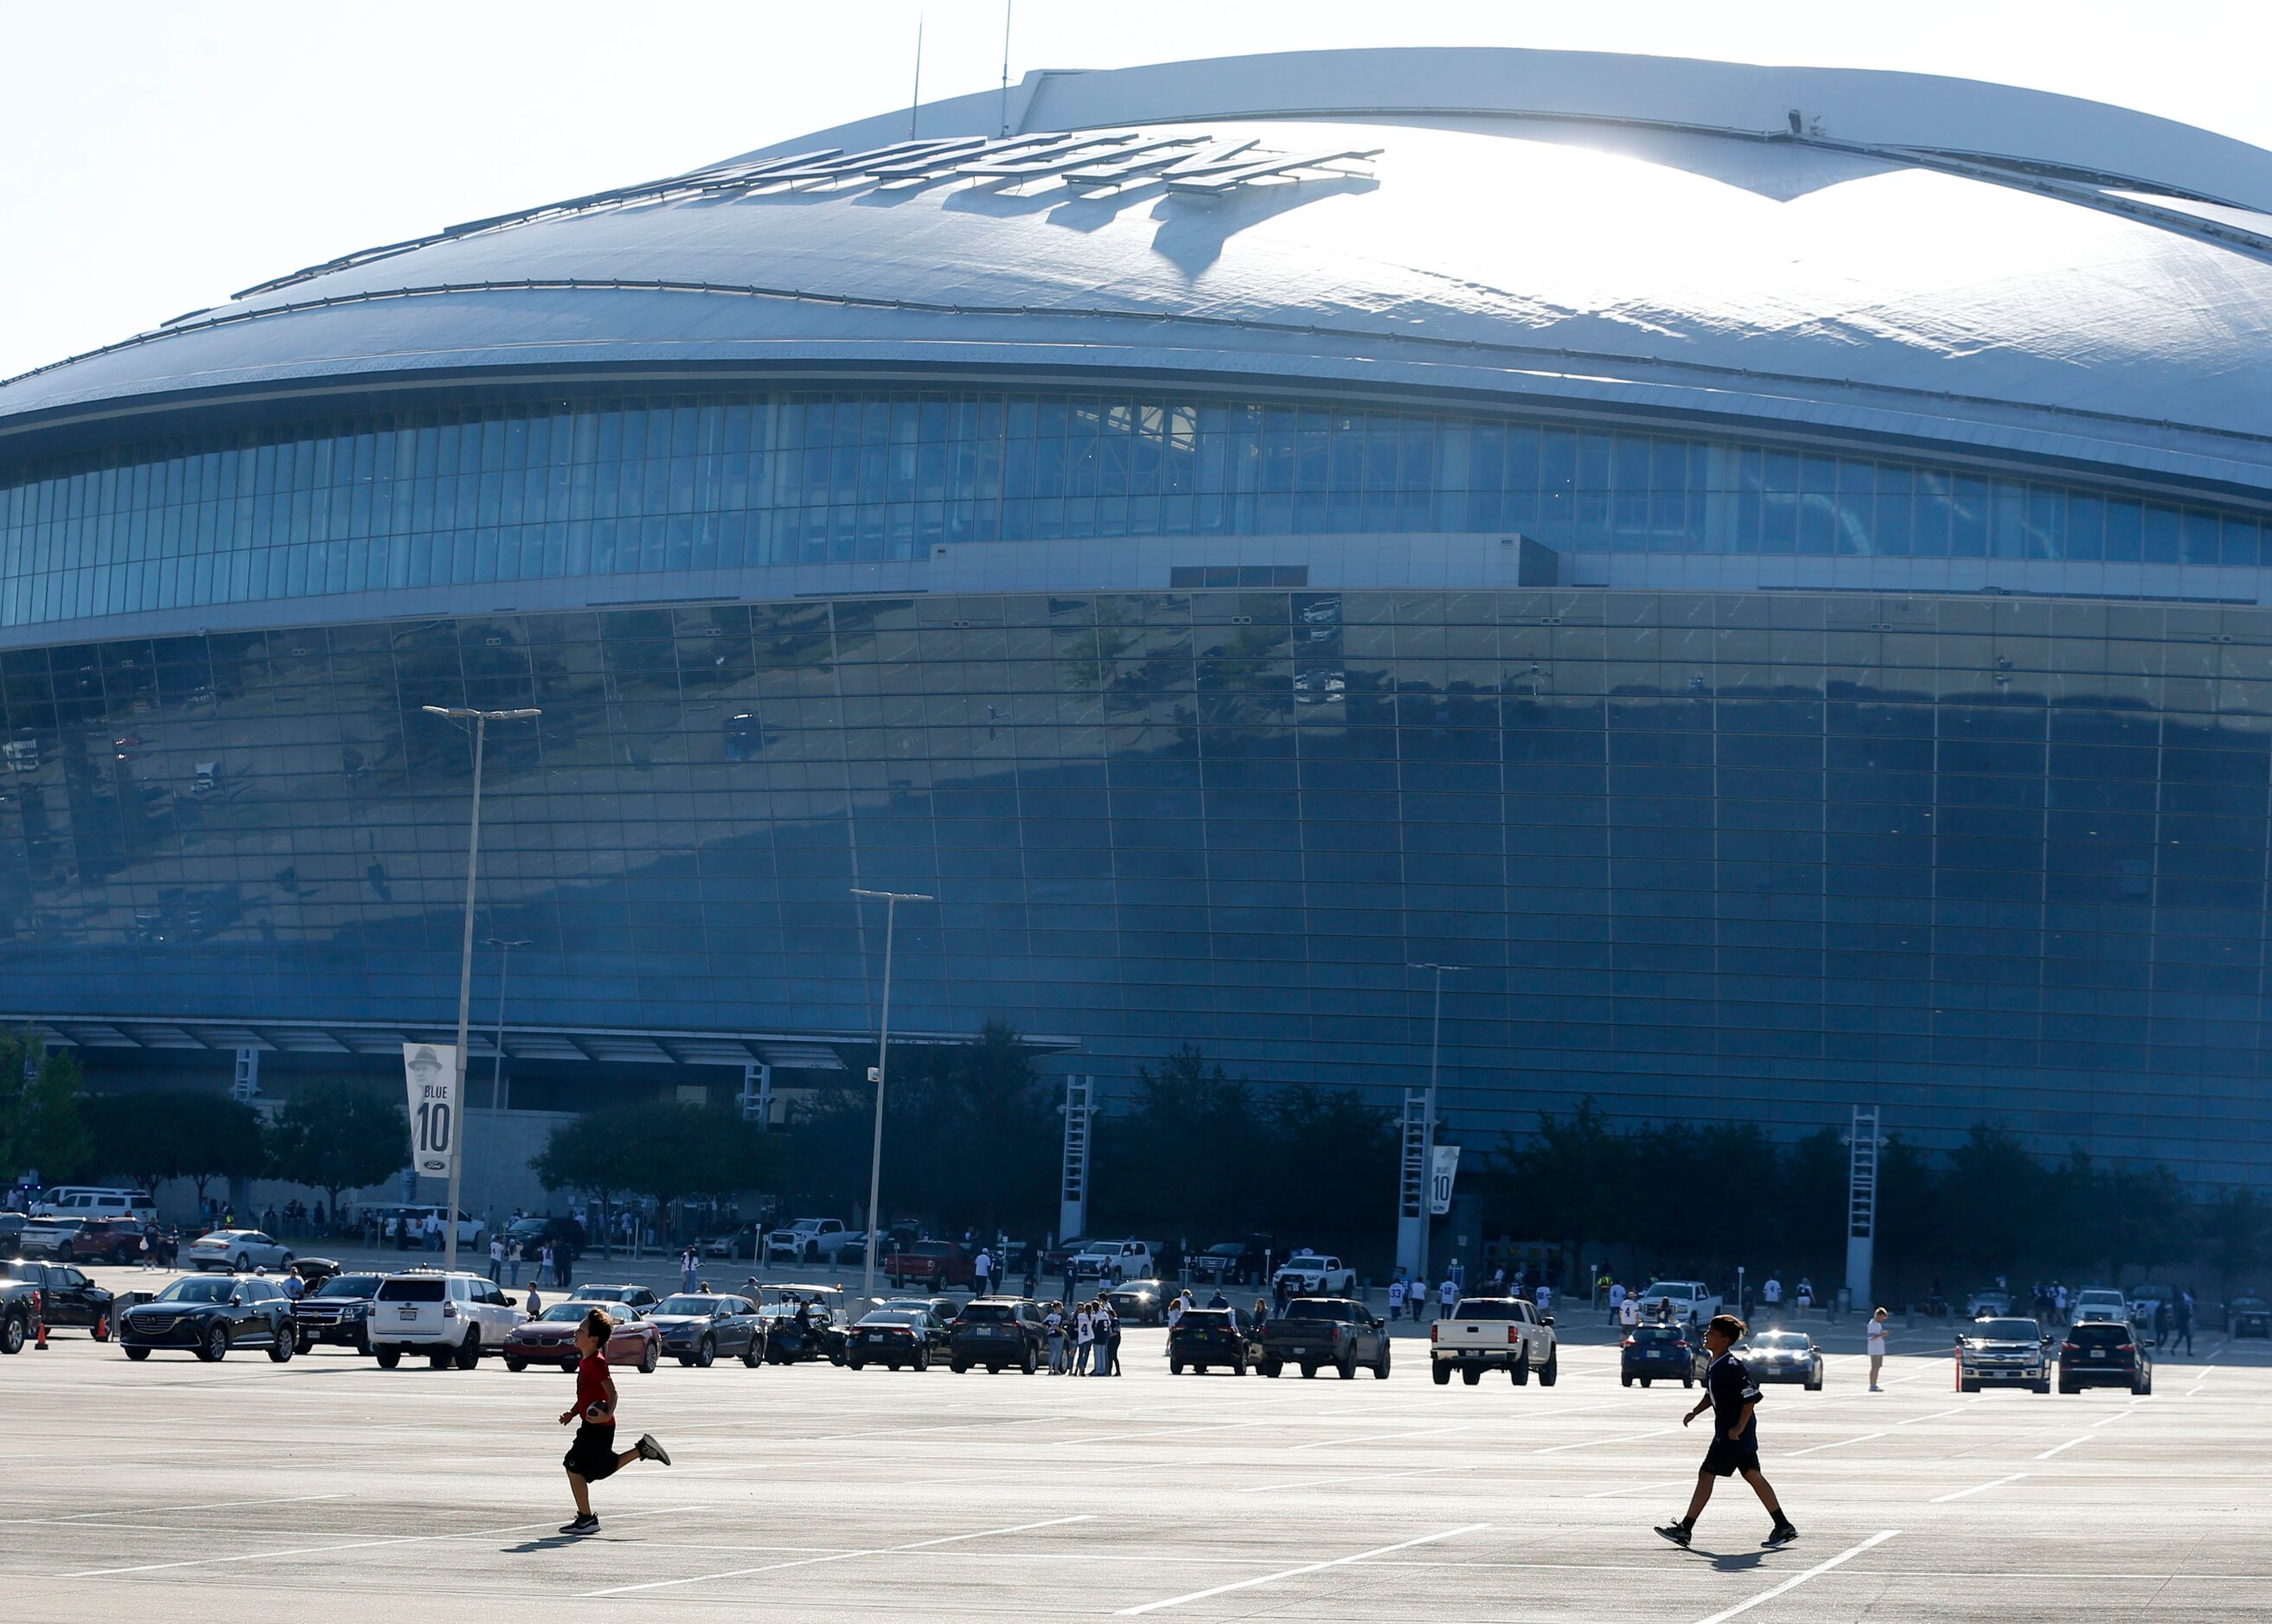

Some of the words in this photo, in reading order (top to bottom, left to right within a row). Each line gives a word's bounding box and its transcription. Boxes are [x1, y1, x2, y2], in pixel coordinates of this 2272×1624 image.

[425, 1085, 448, 1098] BLUE
[418, 1103, 450, 1152] 10
[1433, 1175, 1449, 1201] 10
[1390, 1289, 1401, 1298] 33
[1443, 1287, 1452, 1295] 12
[1625, 1307, 1630, 1317] 4
[1081, 1323, 1088, 1336] 4
[1103, 1320, 1108, 1332] 9
